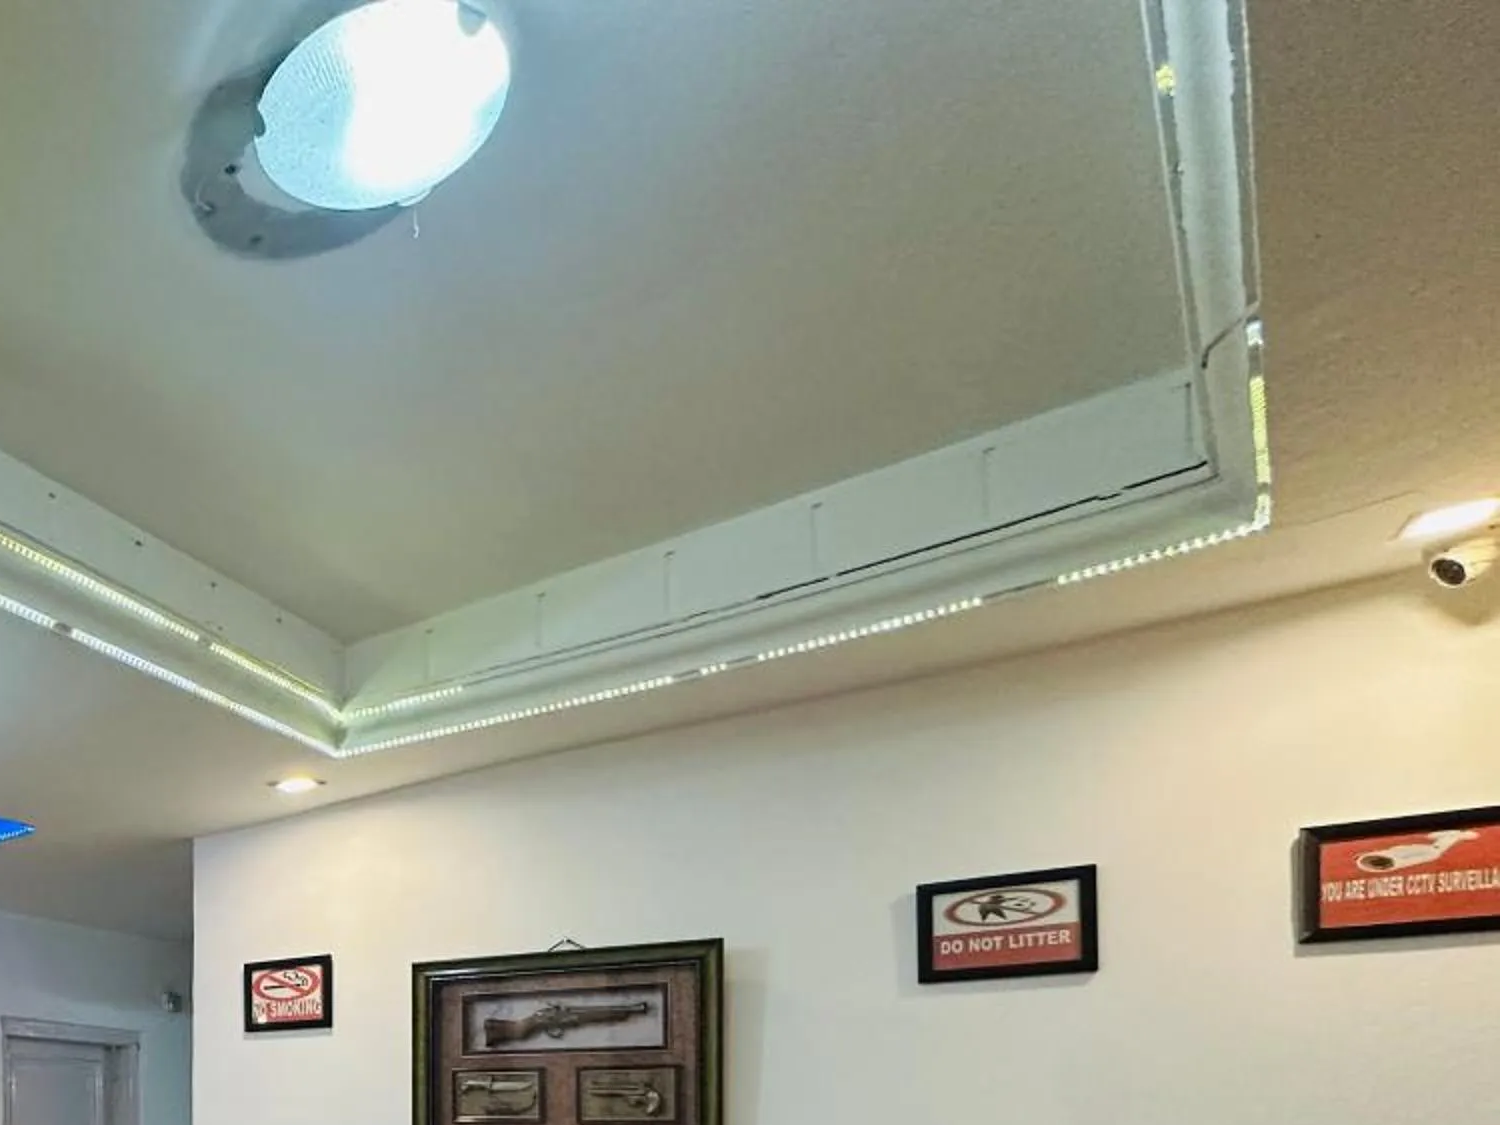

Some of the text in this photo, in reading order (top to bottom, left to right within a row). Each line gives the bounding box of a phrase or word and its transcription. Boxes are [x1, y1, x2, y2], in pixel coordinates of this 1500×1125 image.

[1345, 879, 1365, 900] ARE
[1367, 876, 1404, 899] UNDER
[1407, 873, 1435, 895] CCTV
[940, 930, 1071, 955] DO NOT LITTER
[269, 999, 321, 1018] SMOKING
